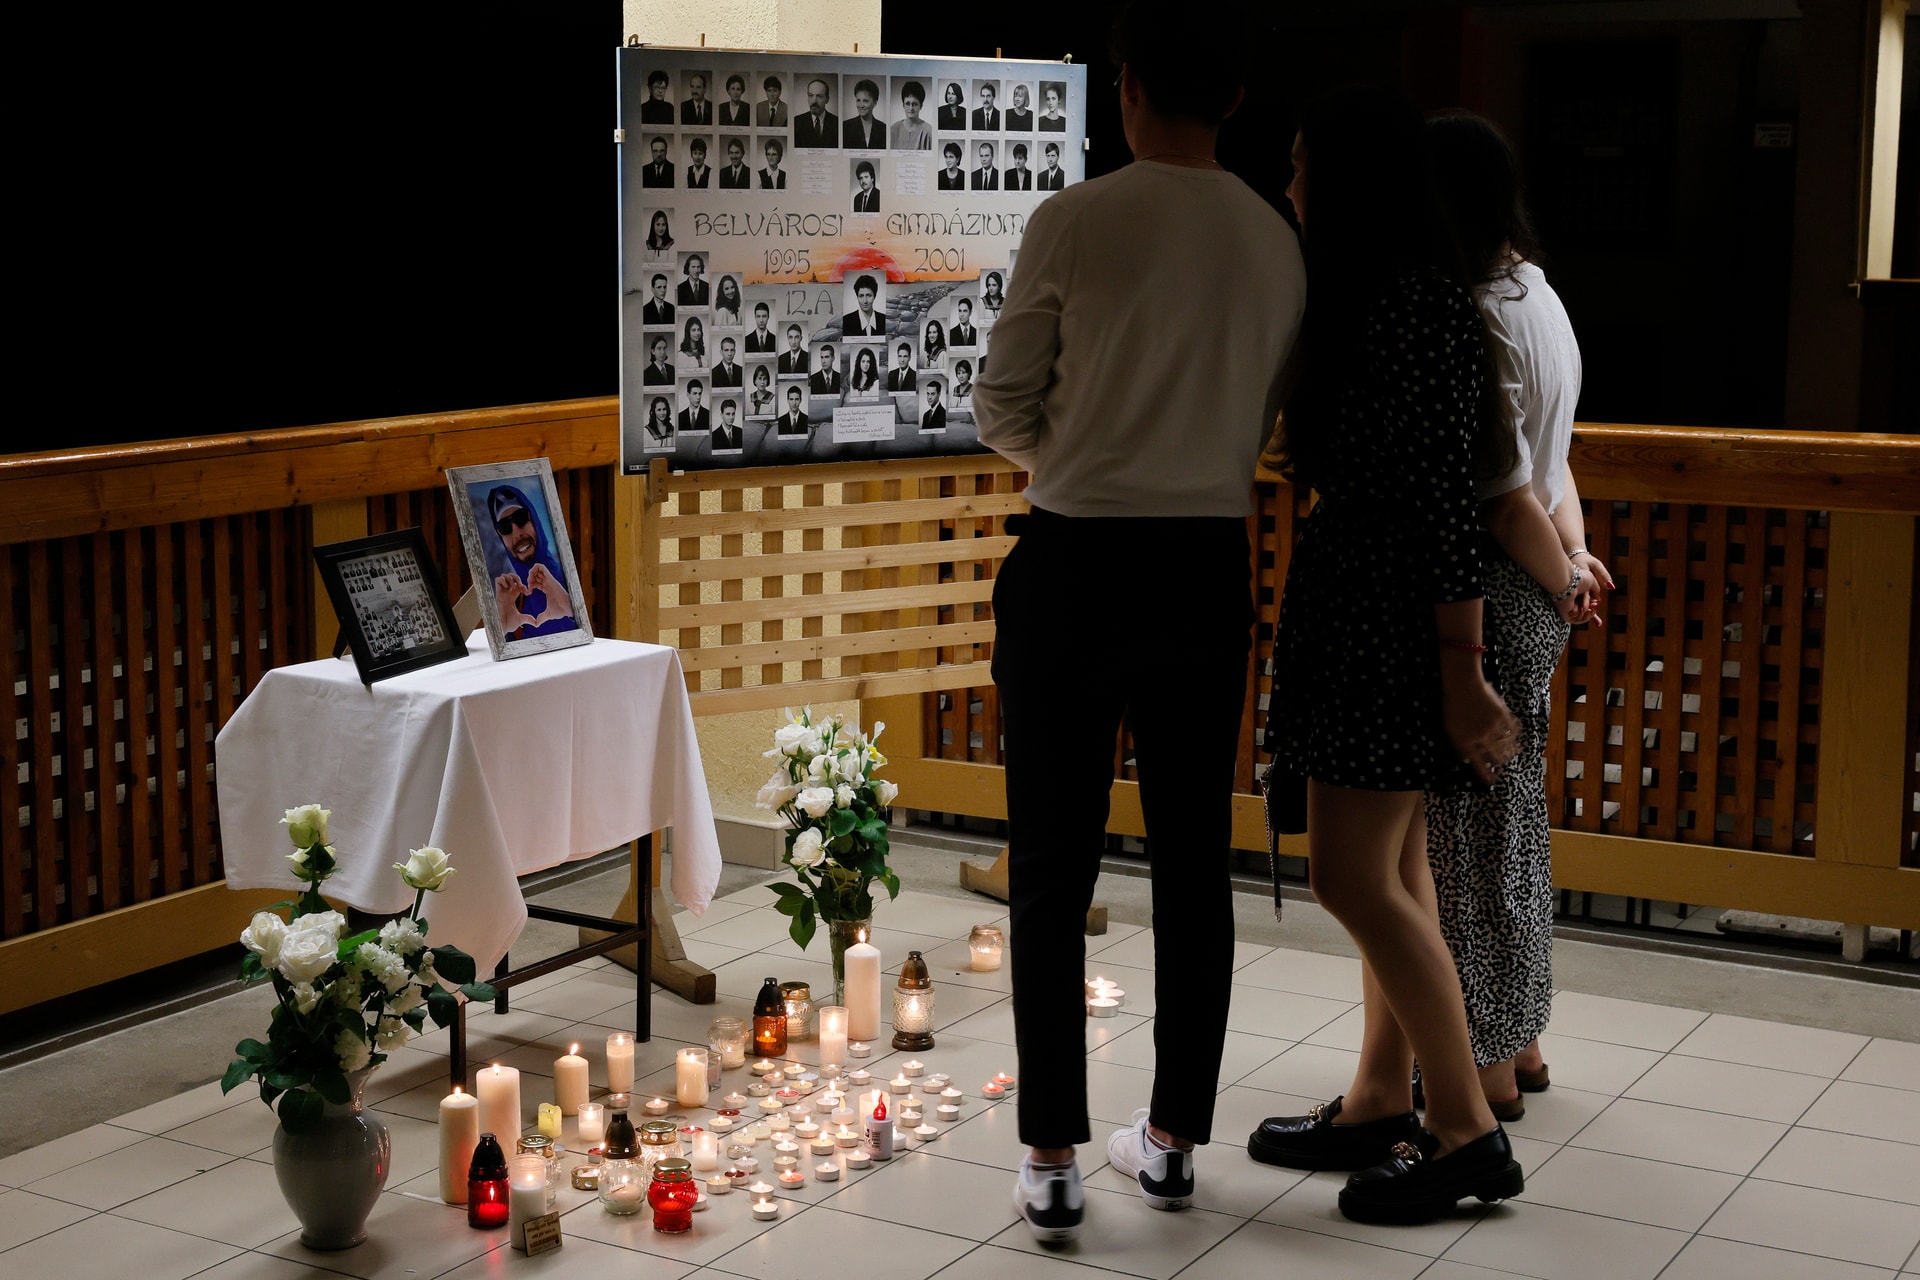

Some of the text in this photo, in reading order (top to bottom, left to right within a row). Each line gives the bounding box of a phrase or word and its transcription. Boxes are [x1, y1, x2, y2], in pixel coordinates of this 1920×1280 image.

[693, 207, 1025, 237] BELVÁROSI GIMNÁZIUM
[763, 247, 965, 275] 1995 2001
